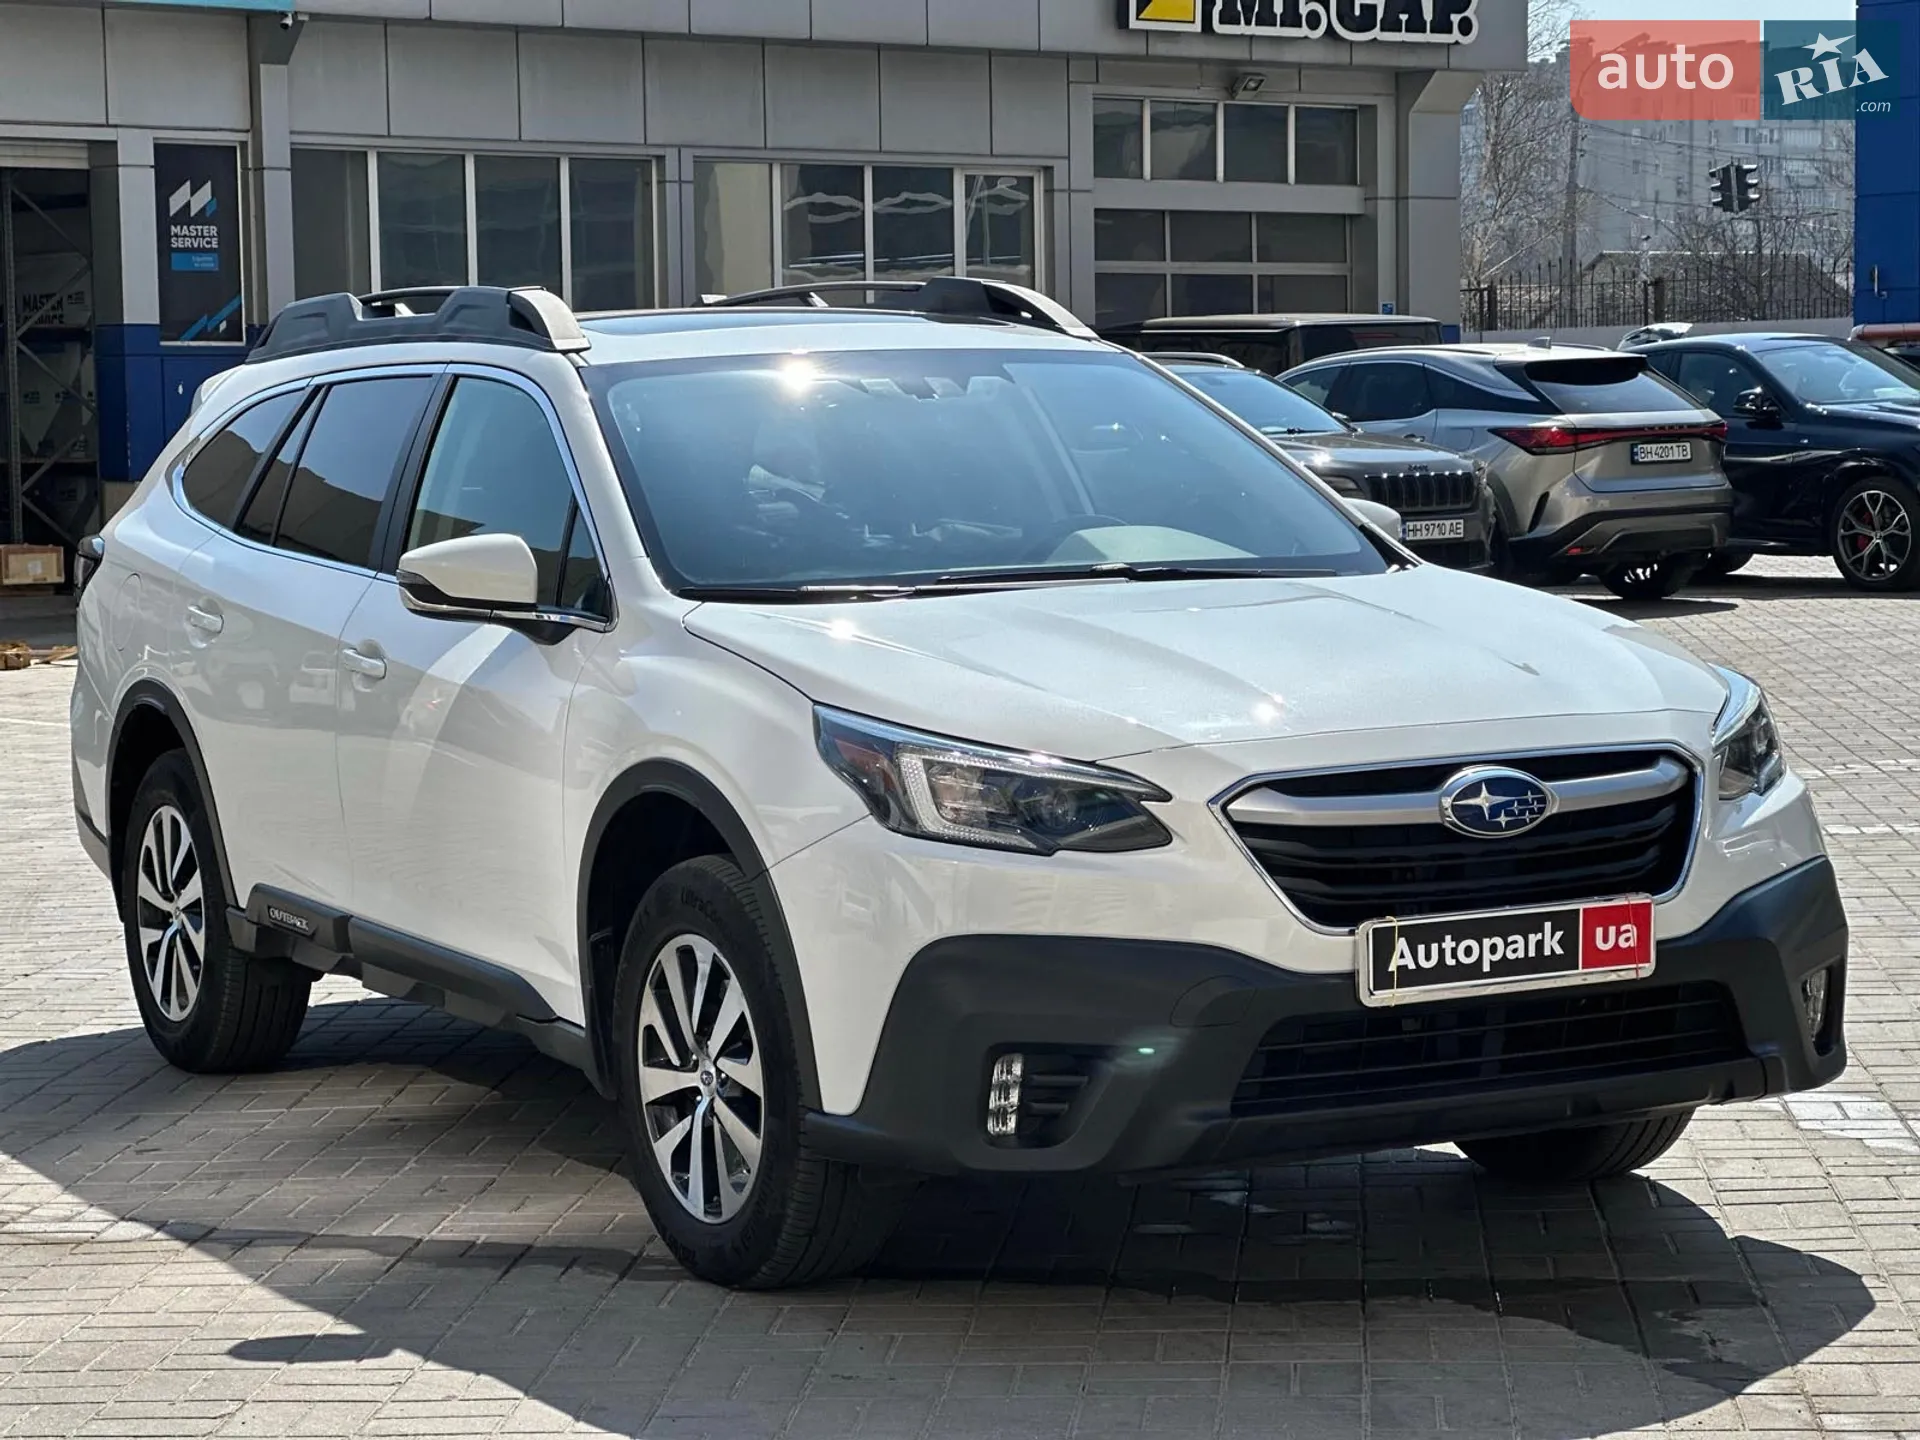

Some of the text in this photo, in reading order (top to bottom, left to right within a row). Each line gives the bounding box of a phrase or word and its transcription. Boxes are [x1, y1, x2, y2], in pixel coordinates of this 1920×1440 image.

[170, 225, 218, 236] MASTER
[170, 237, 219, 249] SERVICE
[1639, 444, 1688, 460] BH 4201 TB
[1407, 523, 1423, 537] HH
[1449, 521, 1462, 536] AE
[1388, 921, 1638, 973] Autopark ua
